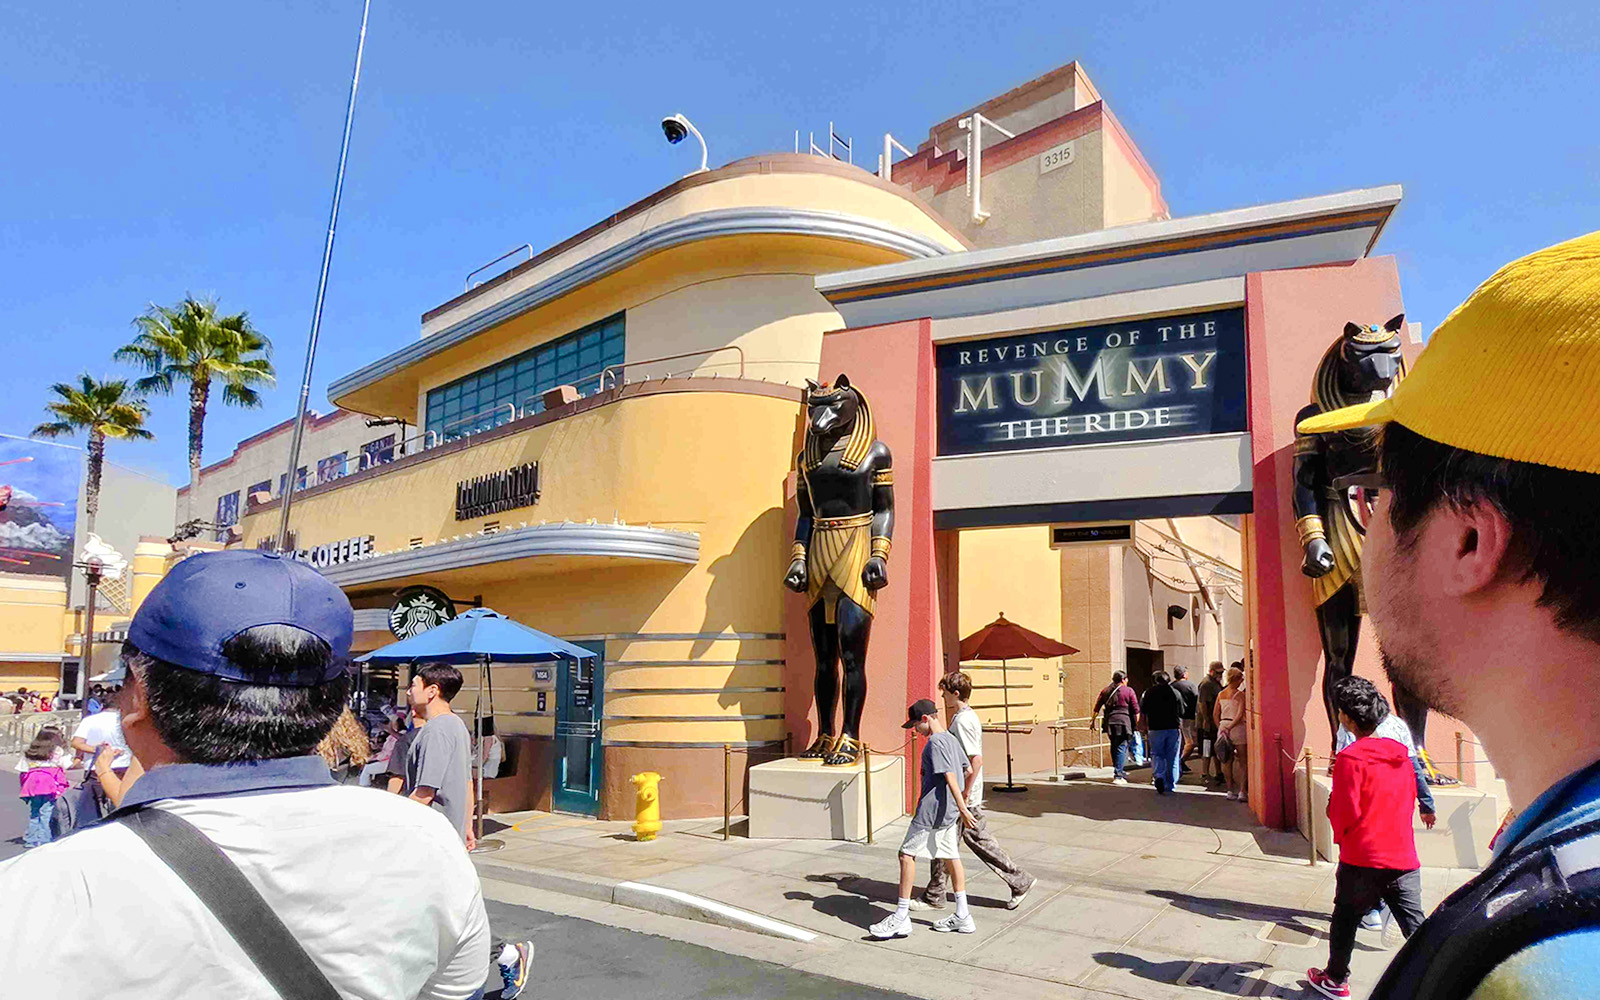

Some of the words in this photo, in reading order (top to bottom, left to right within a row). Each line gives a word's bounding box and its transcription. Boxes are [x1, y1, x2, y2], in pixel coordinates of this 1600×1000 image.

[1044, 147, 1071, 167] 3315
[959, 337, 1088, 365] REVENGE
[1105, 330, 1140, 348] OF
[1158, 321, 1216, 342] THE
[954, 351, 1217, 413] MUMMY
[1000, 416, 1070, 440] THE
[1084, 407, 1171, 433] RIDE
[309, 535, 374, 569] COFFEE
